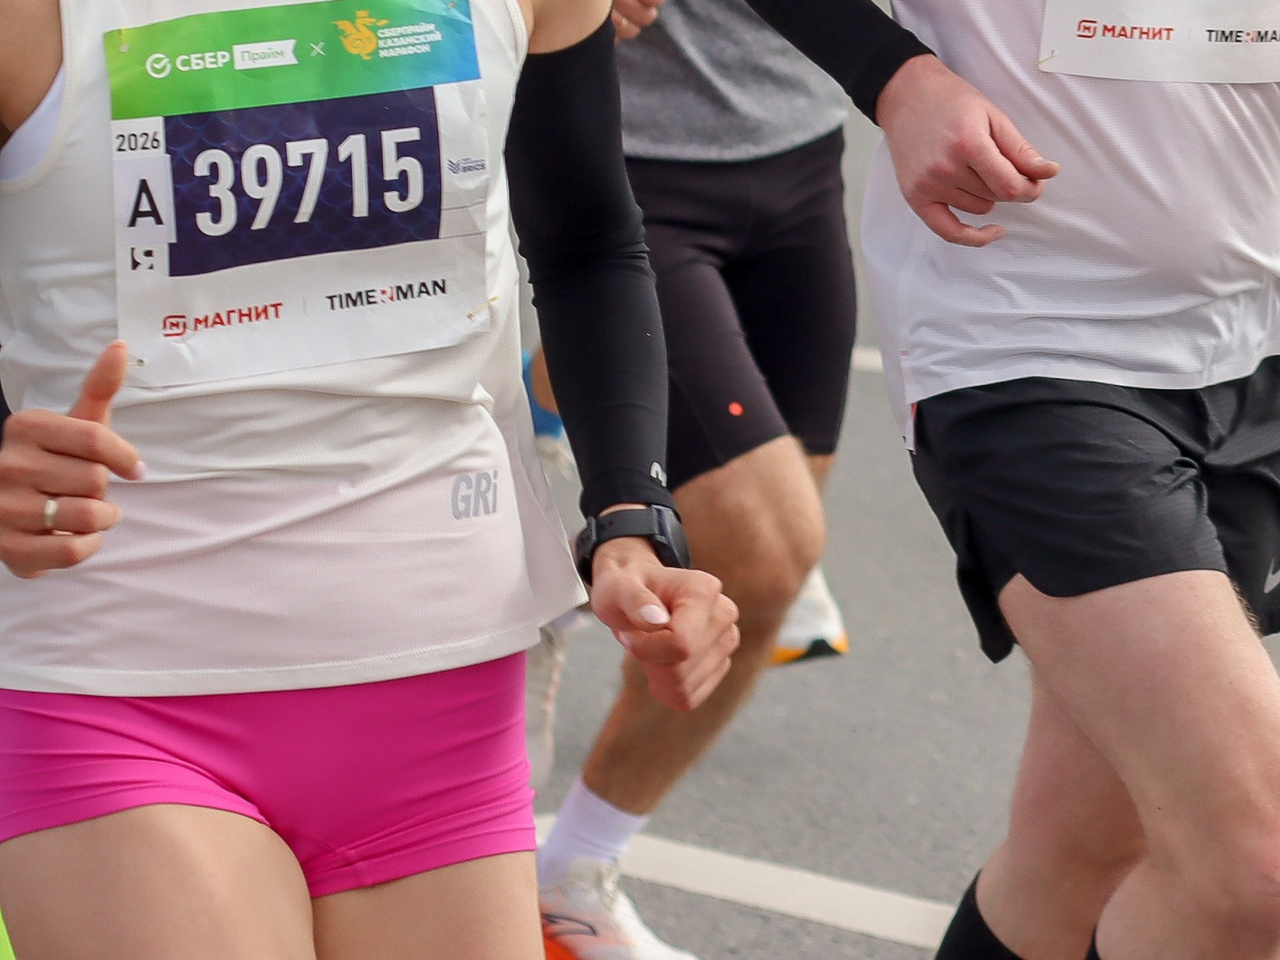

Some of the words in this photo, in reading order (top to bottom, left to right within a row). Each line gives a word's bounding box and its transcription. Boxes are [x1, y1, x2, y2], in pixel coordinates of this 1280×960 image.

[1102, 24, 1174, 41] МАГНИТ
[175, 50, 231, 72] СБЕР
[116, 130, 161, 152] 2026
[193, 126, 425, 237] 39715
[194, 302, 284, 331] МАГНИТ
